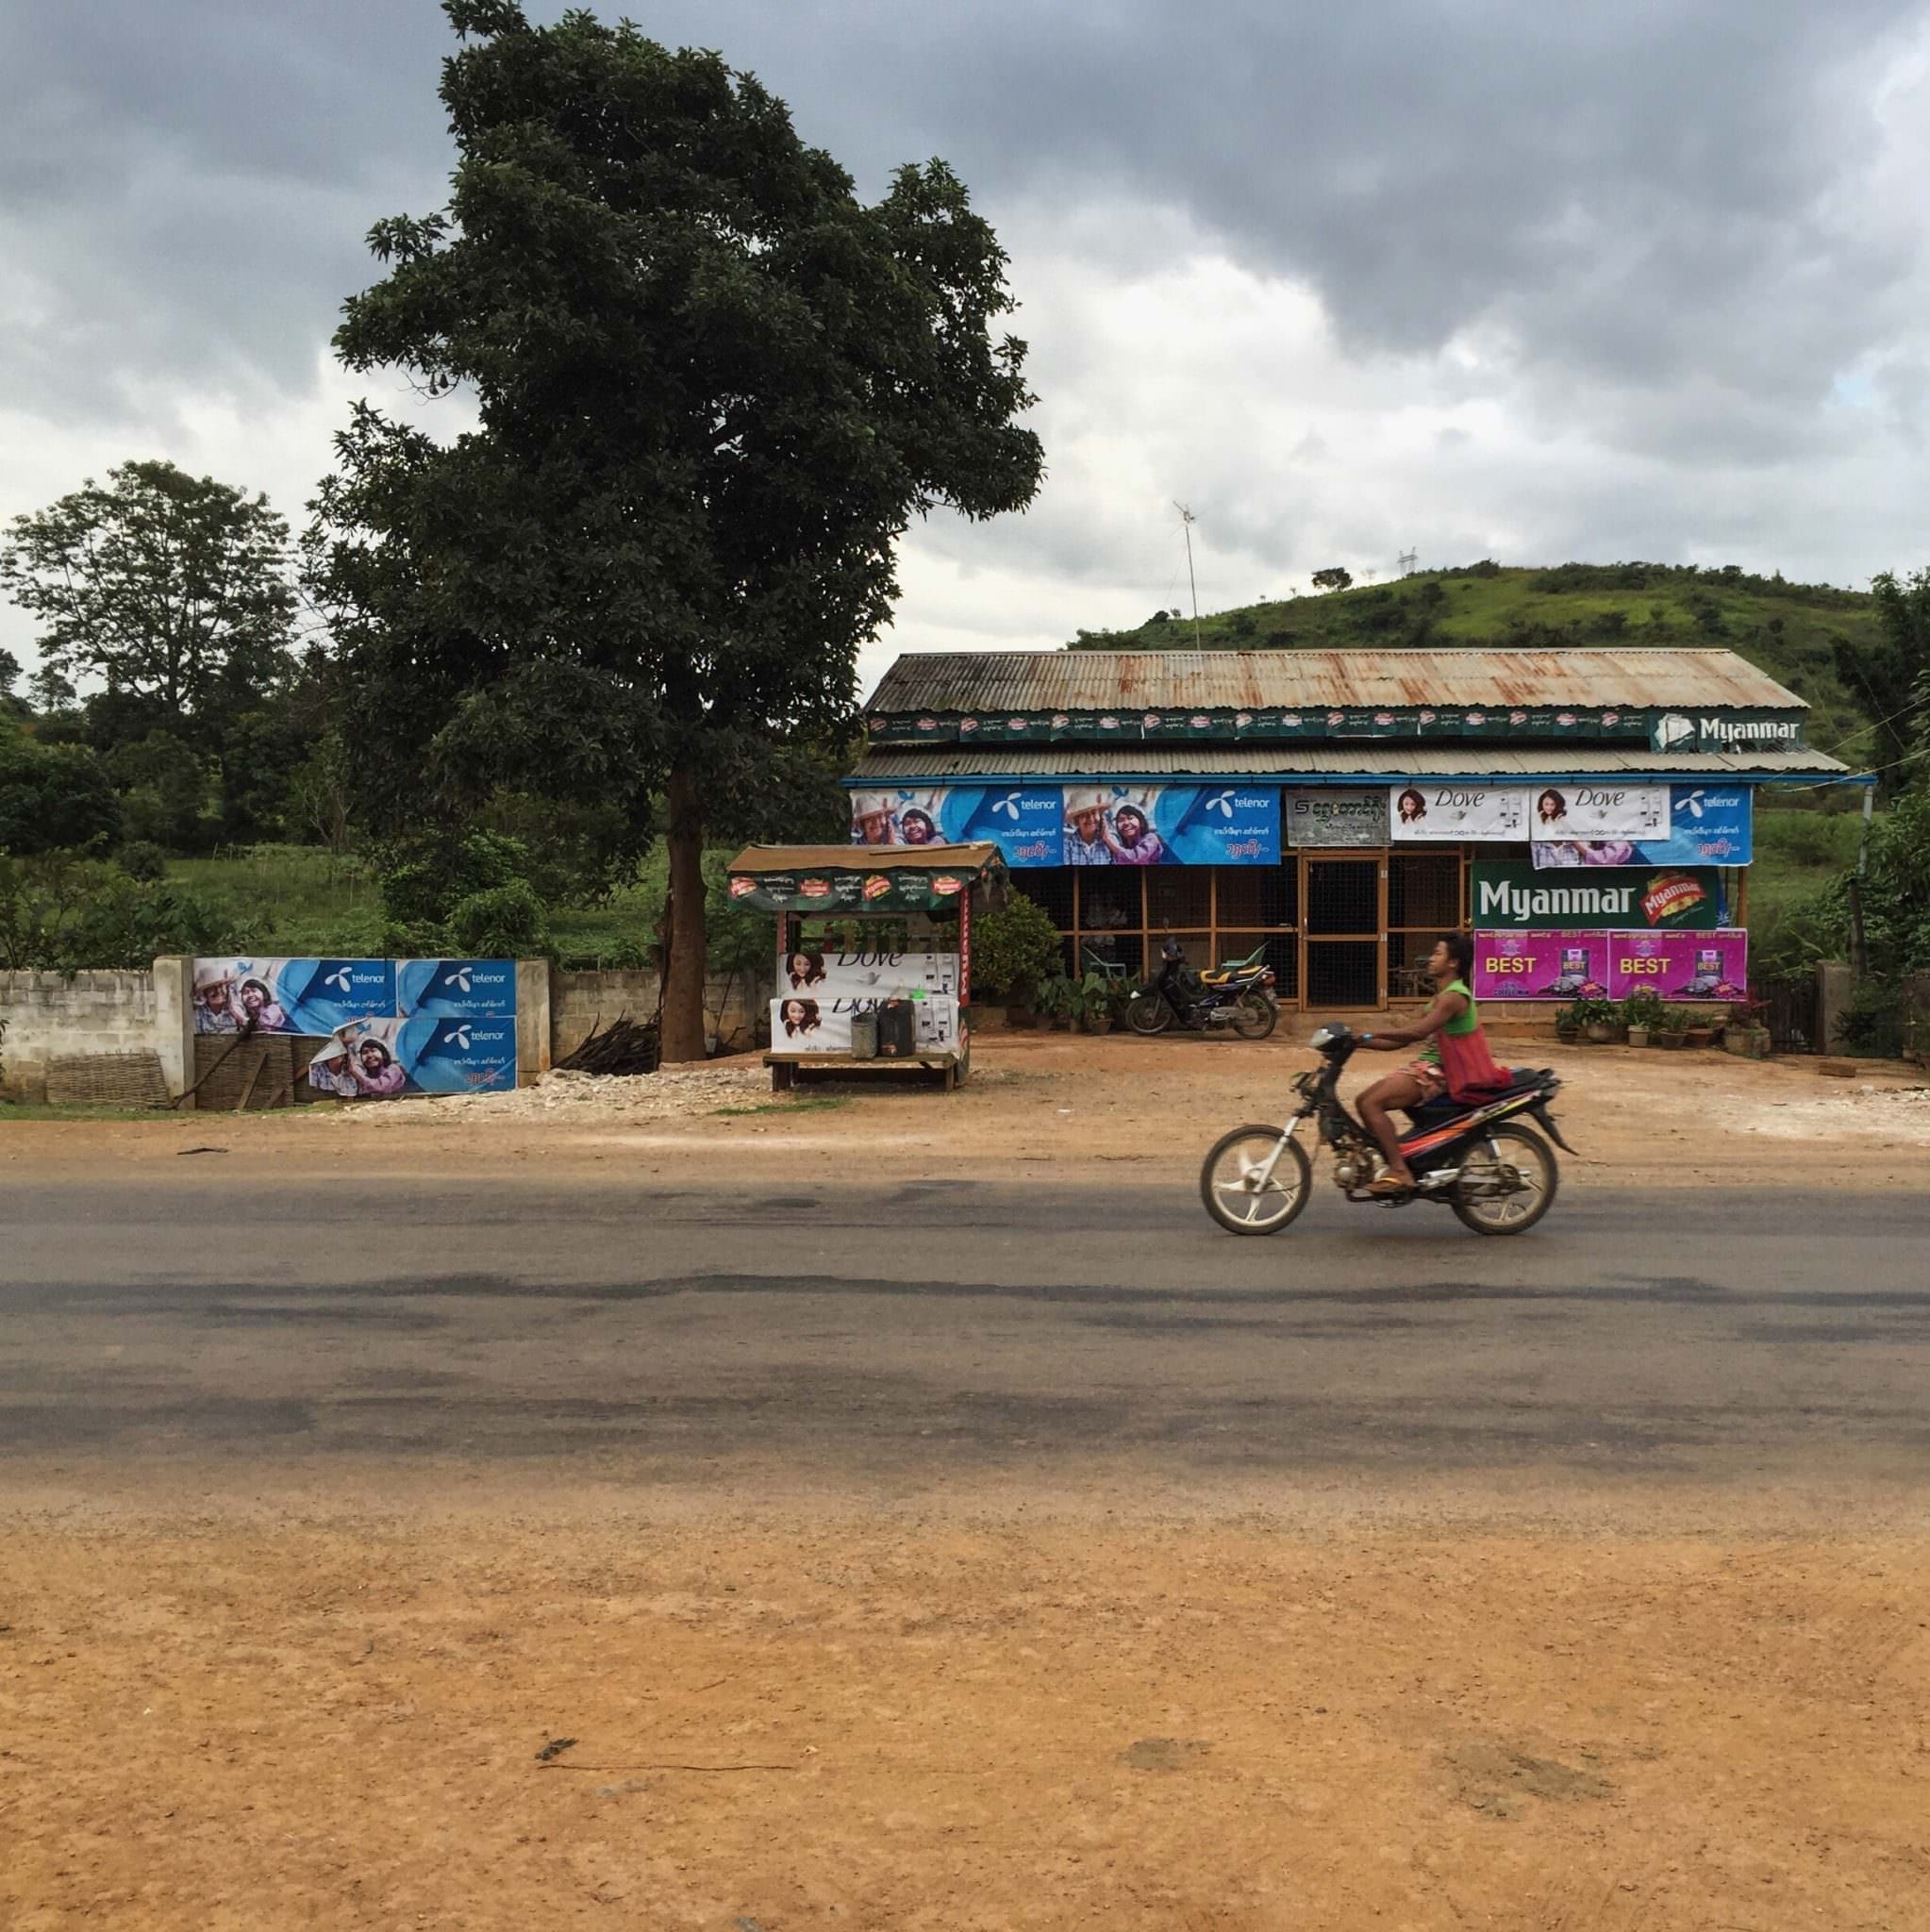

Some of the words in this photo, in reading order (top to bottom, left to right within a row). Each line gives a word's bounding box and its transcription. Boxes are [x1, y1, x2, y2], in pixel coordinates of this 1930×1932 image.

[1700, 718, 1800, 743] Myanmar
[1234, 797, 1270, 808] telenor
[1435, 788, 1486, 807] Dove
[1575, 787, 1625, 807] Dove
[1704, 796, 1739, 808] telenor
[1021, 799, 1057, 810] telenor
[1479, 880, 1638, 922] Myanmar
[1486, 958, 1537, 974] BEST
[1563, 961, 1586, 970] BEST
[1620, 958, 1672, 974] BEST
[352, 973, 386, 984] telenor
[472, 973, 506, 984] telenor
[471, 1030, 506, 1041] telenor
